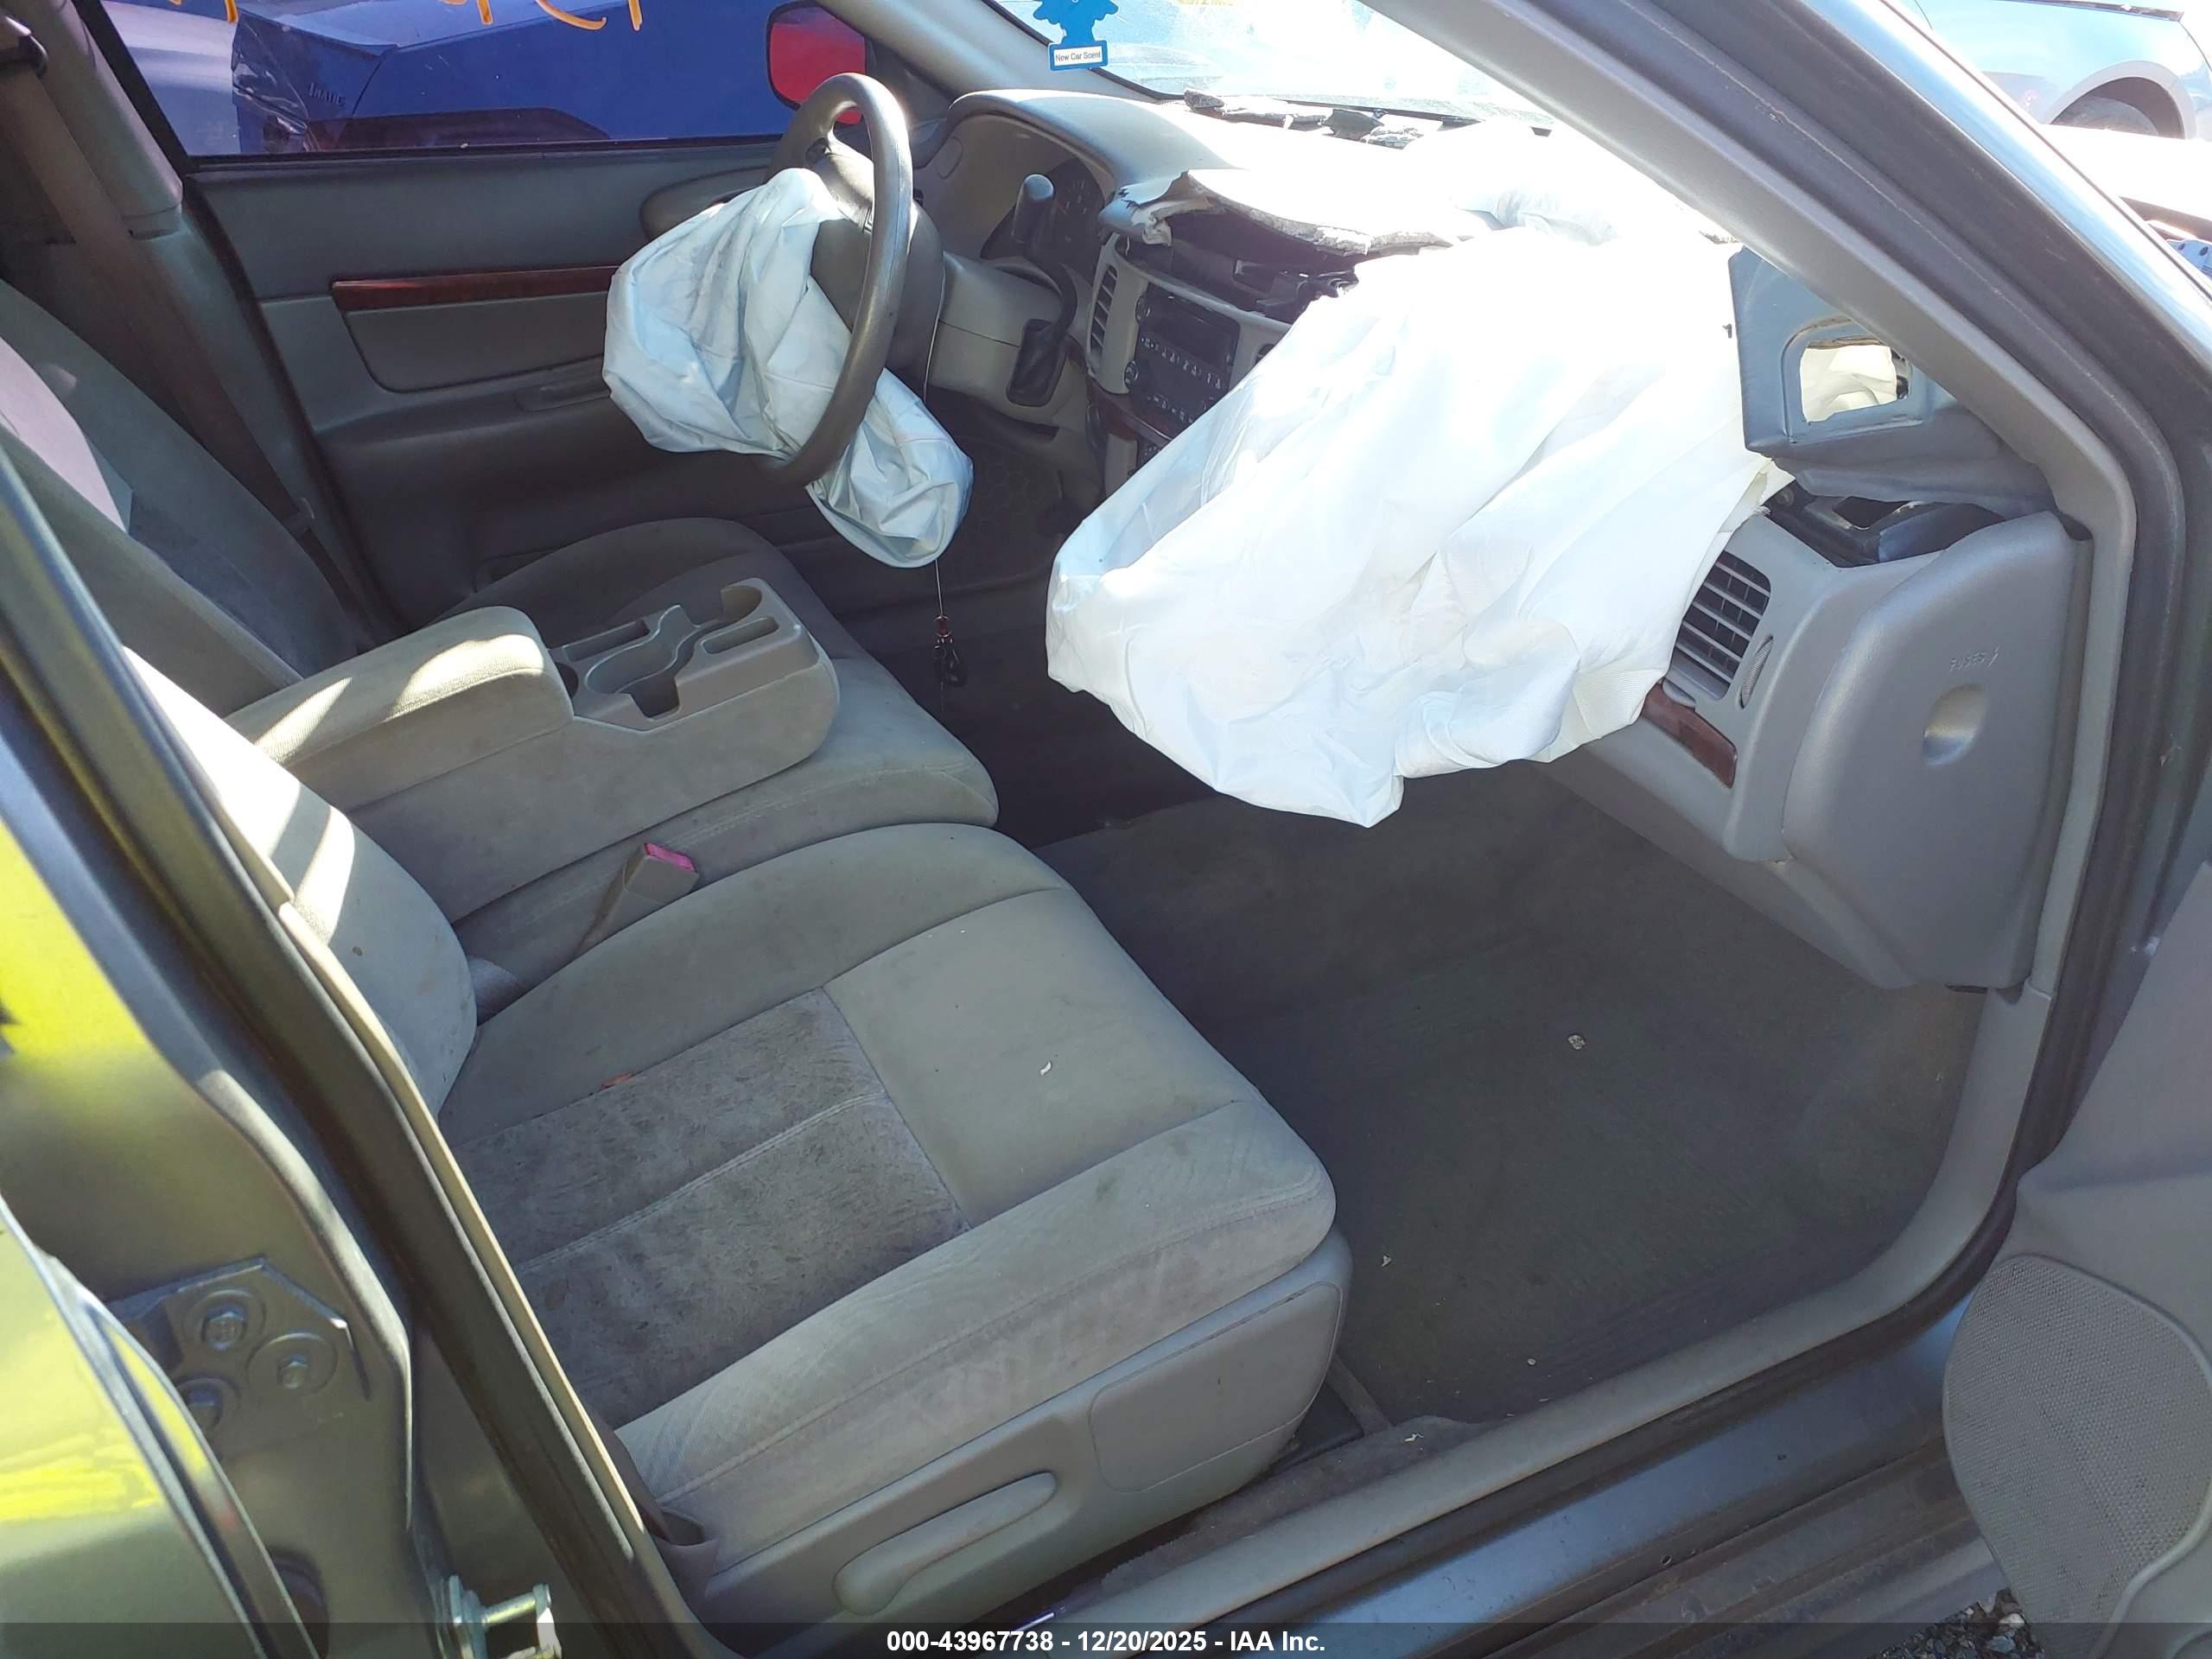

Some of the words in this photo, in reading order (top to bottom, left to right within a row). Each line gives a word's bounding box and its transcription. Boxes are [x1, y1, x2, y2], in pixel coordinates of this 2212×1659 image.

[1055, 53, 1070, 62] New
[1071, 52, 1083, 60] Car
[1084, 50, 1101, 60] Scent
[1949, 651, 1986, 672] FUSES
